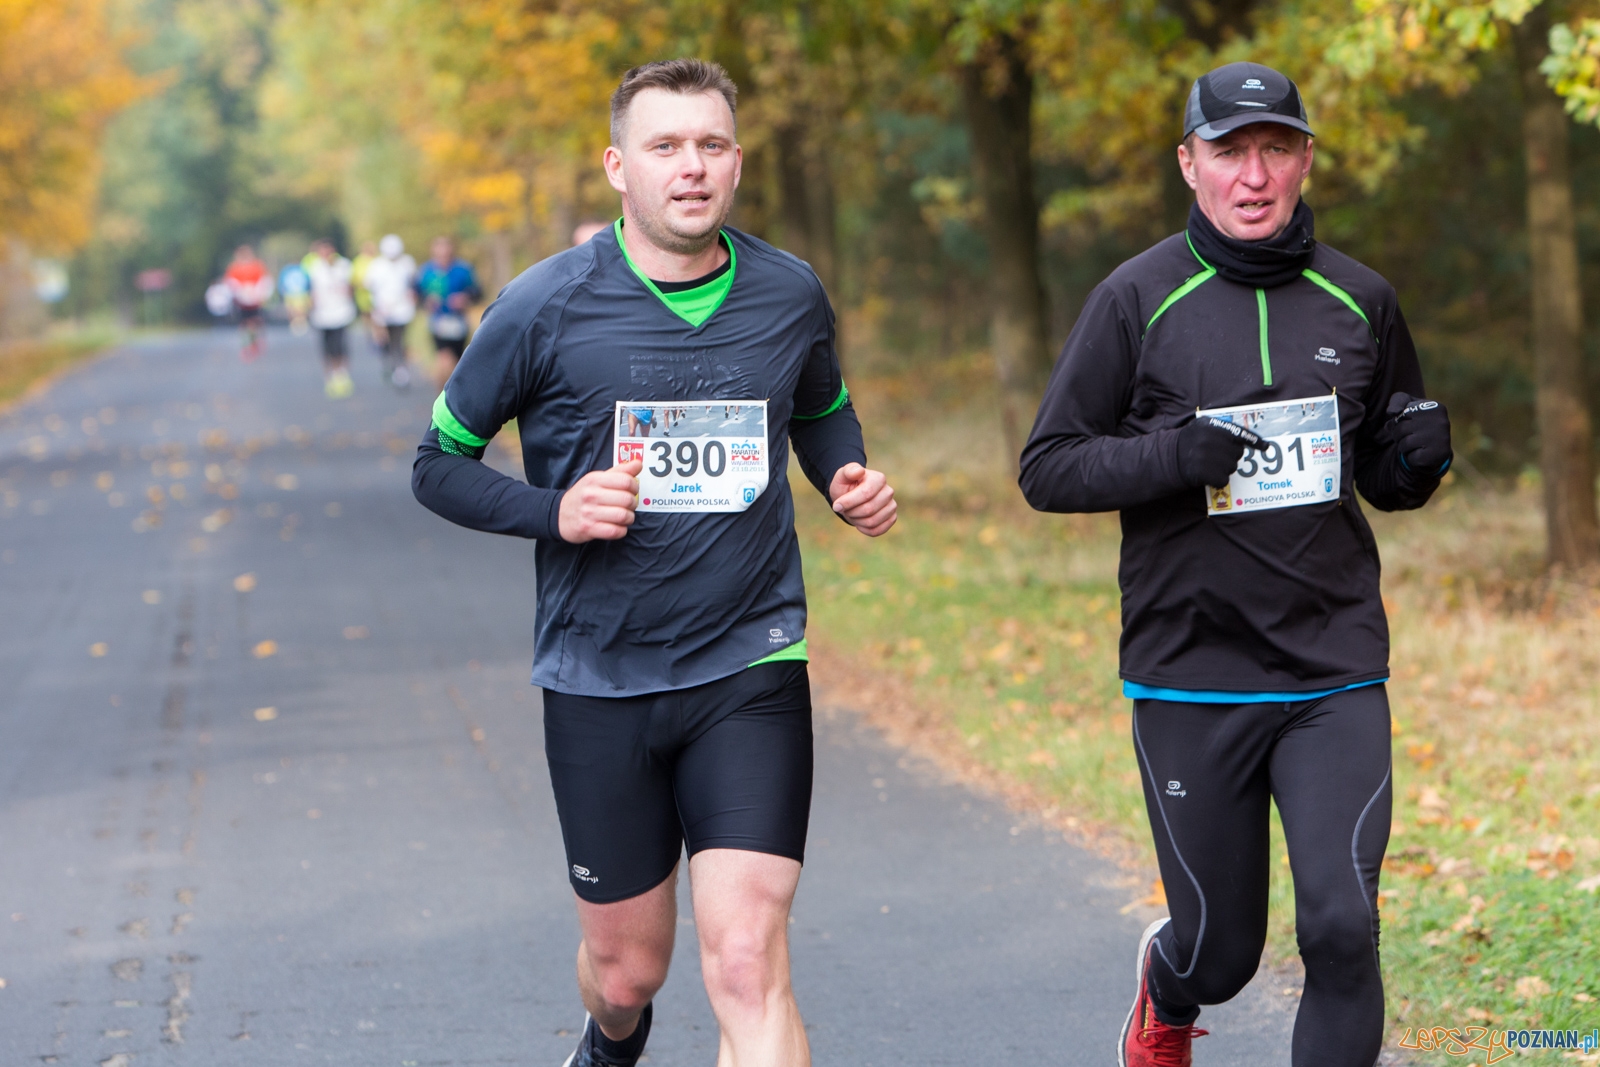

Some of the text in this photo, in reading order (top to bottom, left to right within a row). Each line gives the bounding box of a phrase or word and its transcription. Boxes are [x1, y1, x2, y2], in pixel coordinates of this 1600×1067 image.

[1314, 353, 1341, 366] Kalenji
[648, 440, 726, 477] 390
[671, 482, 702, 493] Jarek
[1257, 478, 1293, 491] Tomek
[652, 498, 730, 506] POLINOVA POLSKA
[1244, 490, 1316, 505] POLINOVA POLSKA
